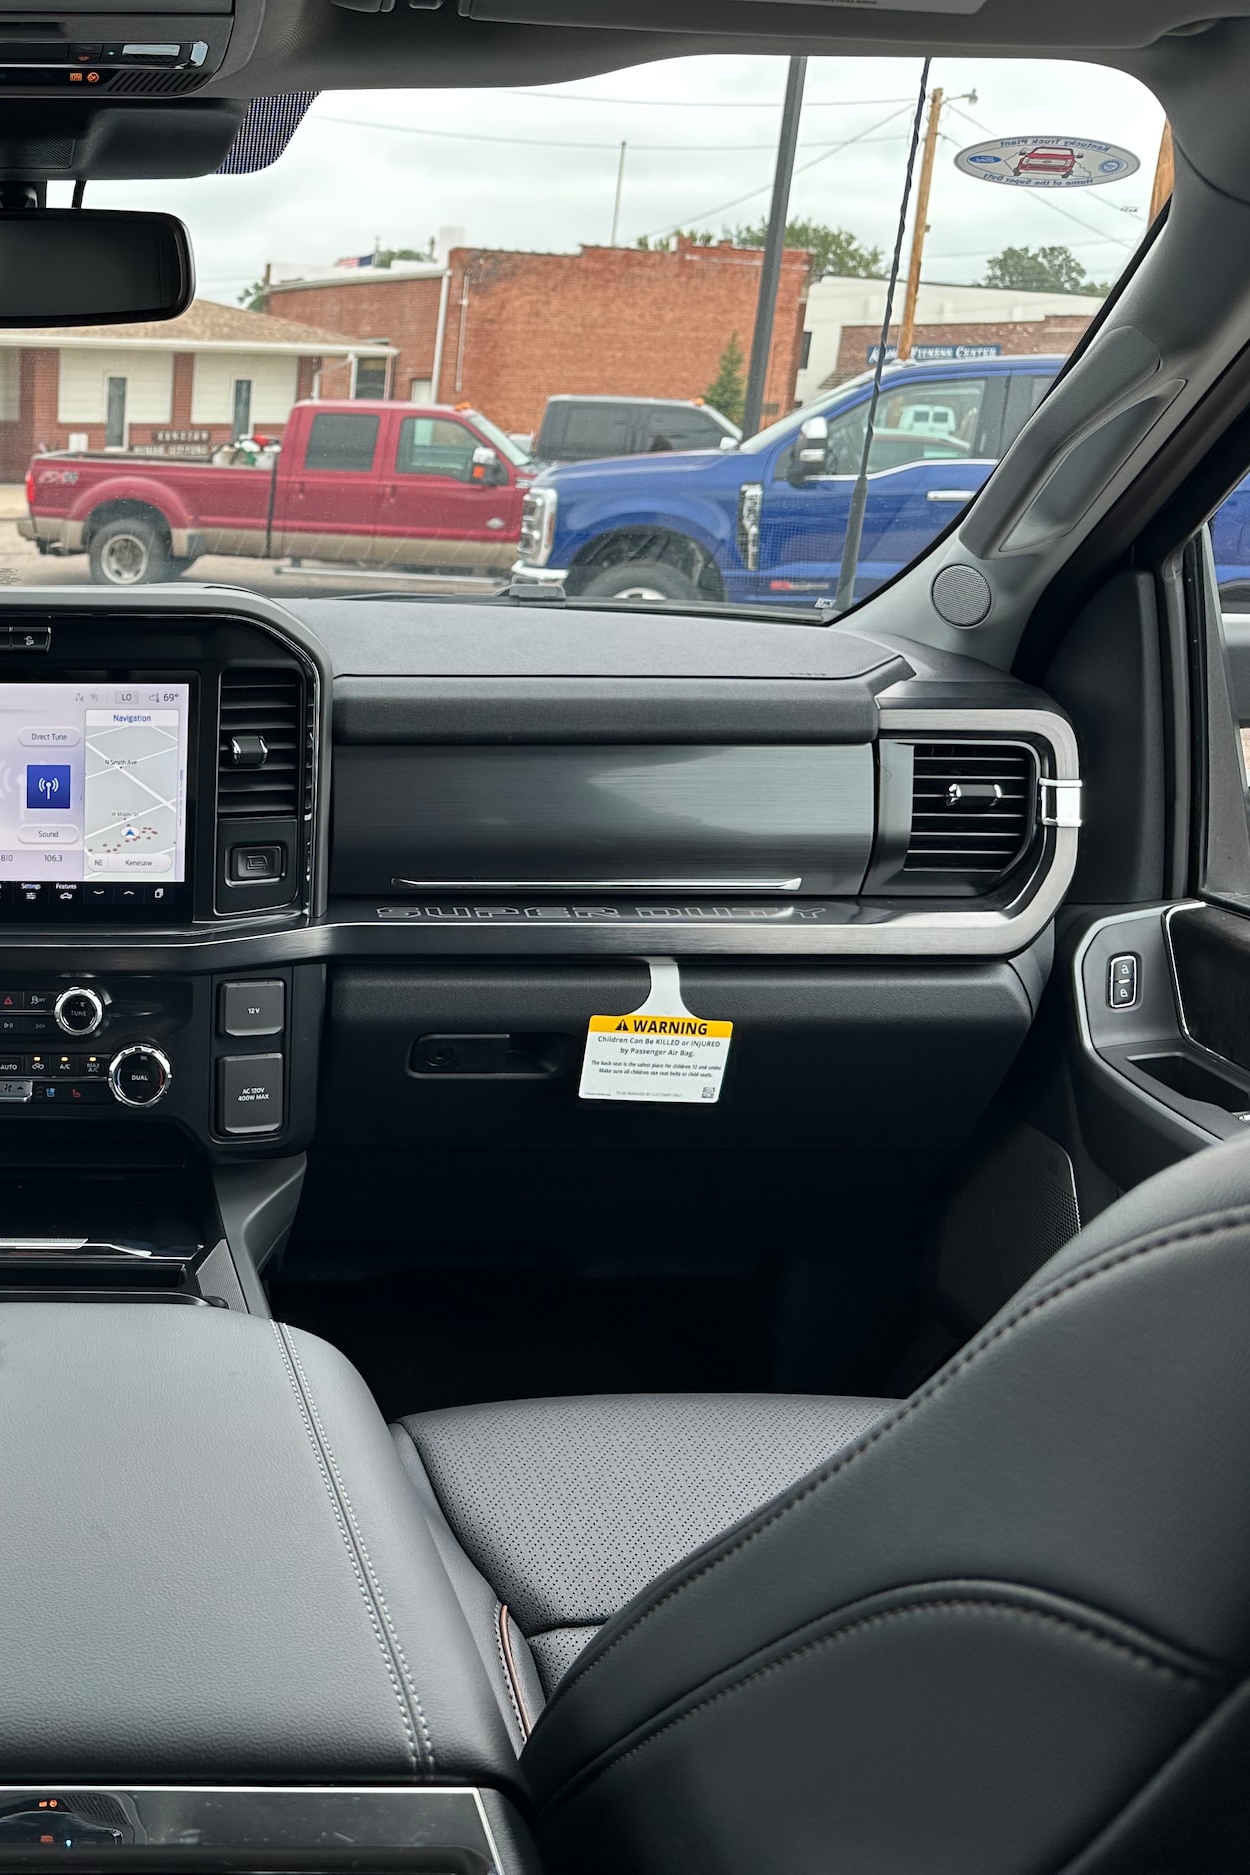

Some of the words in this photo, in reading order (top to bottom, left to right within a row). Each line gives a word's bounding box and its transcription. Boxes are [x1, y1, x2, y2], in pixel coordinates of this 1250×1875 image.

[956, 346, 997, 358] CENTER
[121, 693, 132, 701] LO
[113, 714, 151, 723] Navigation
[31, 733, 50, 741] Direct
[51, 733, 68, 741] Tune
[376, 906, 621, 919] SUPER
[635, 906, 828, 919] DUTY
[633, 1020, 708, 1035] WARNING
[598, 1036, 628, 1044] Children
[690, 1040, 721, 1048] INJURED
[620, 1047, 629, 1055] by
[630, 1048, 666, 1056] Passenger
[680, 1050, 695, 1058] Bag.
